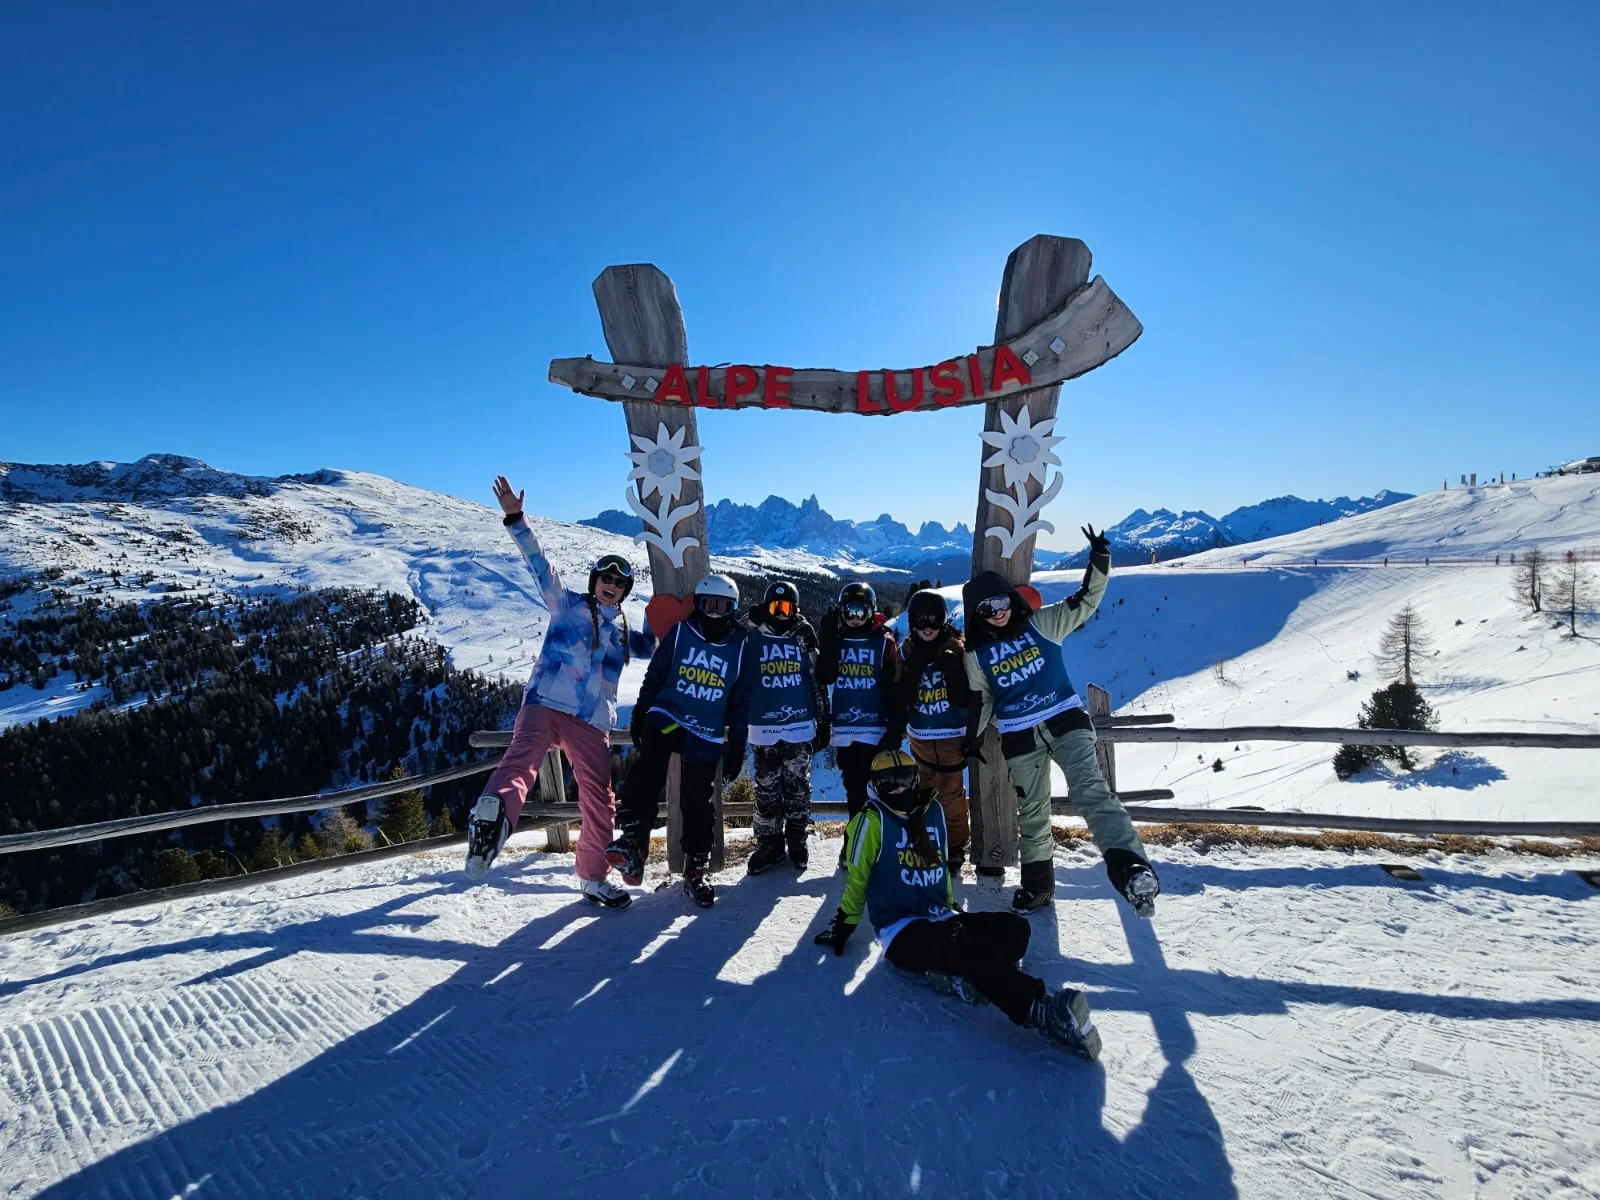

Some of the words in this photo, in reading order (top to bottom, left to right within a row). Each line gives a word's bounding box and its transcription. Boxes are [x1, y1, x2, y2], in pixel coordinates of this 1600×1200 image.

[654, 363, 793, 408] ALPE
[857, 344, 1031, 413] LUSIA
[760, 643, 801, 662] JAFI
[838, 648, 875, 665] JAFI
[992, 646, 1041, 676] POWER
[682, 647, 729, 678] JAFI
[760, 661, 801, 675] POWER
[679, 665, 726, 687] POWER
[761, 674, 802, 689] CAMP
[997, 657, 1045, 688] CAMP
[676, 679, 723, 702] CAMP
[836, 676, 876, 690] CAMP
[918, 687, 948, 704] OWER
[914, 700, 950, 716] AMP
[900, 867, 944, 887] CAMP
